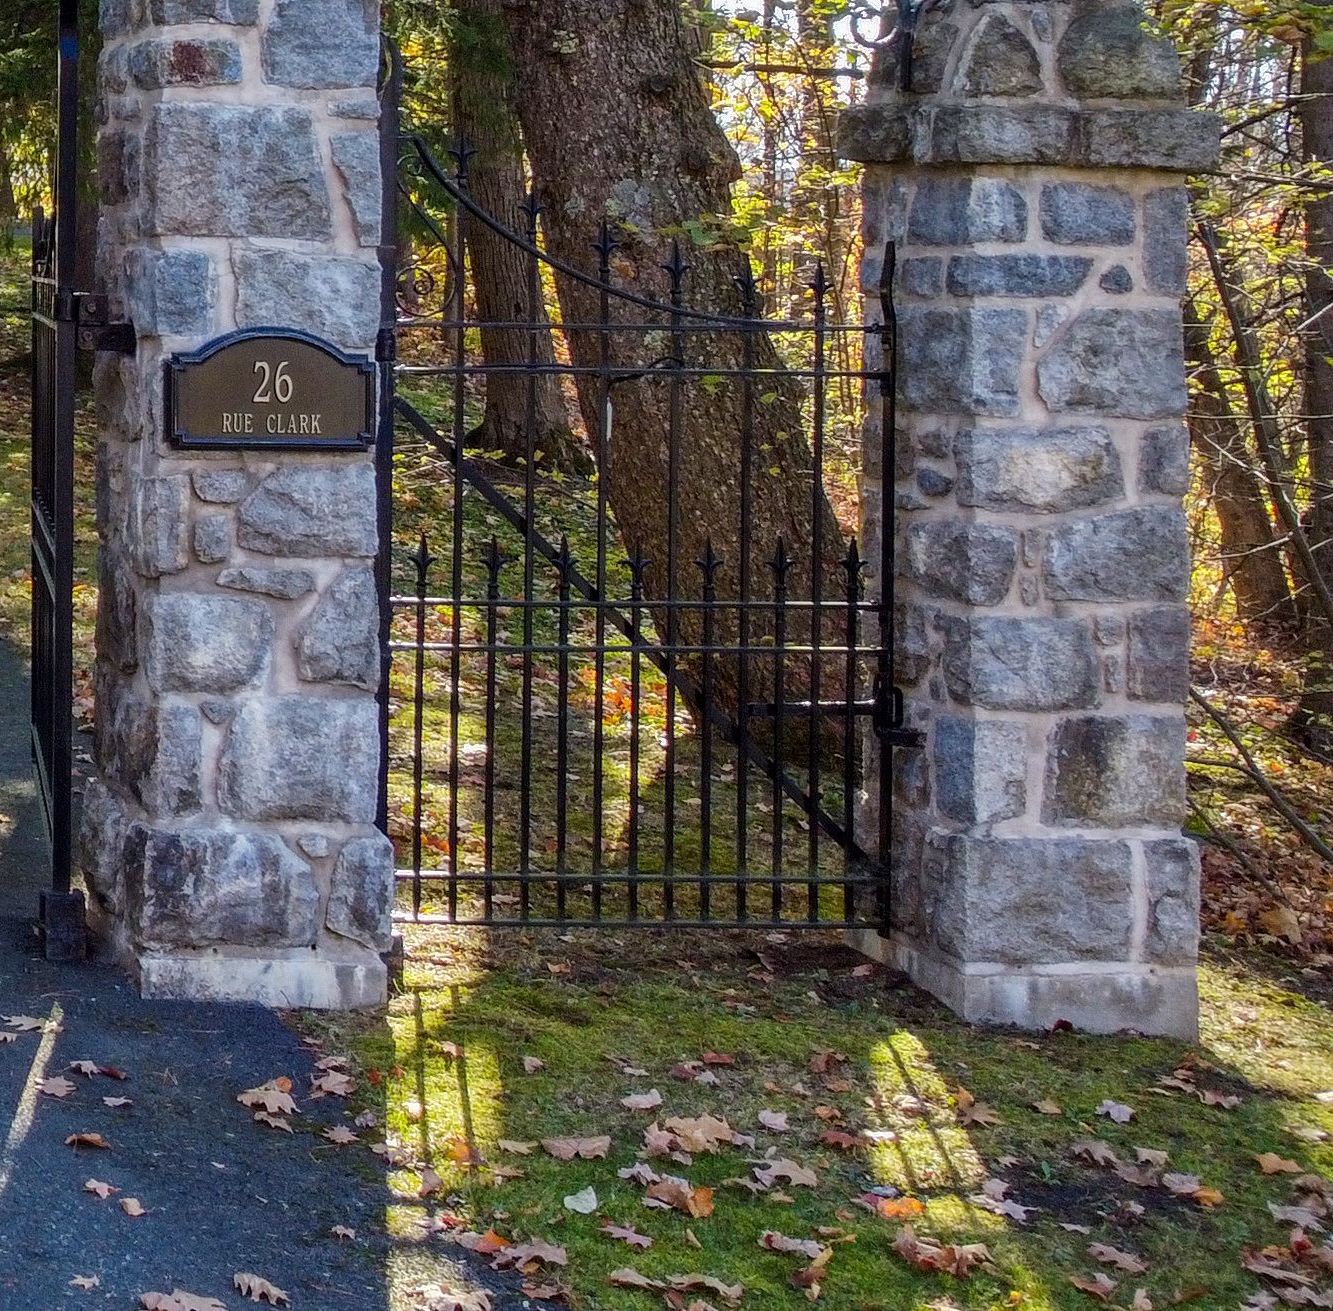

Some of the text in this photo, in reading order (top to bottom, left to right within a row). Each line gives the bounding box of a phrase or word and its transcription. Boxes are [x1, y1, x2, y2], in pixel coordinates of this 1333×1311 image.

[252, 361, 293, 403] 26
[222, 413, 322, 434] RUE CLARK
